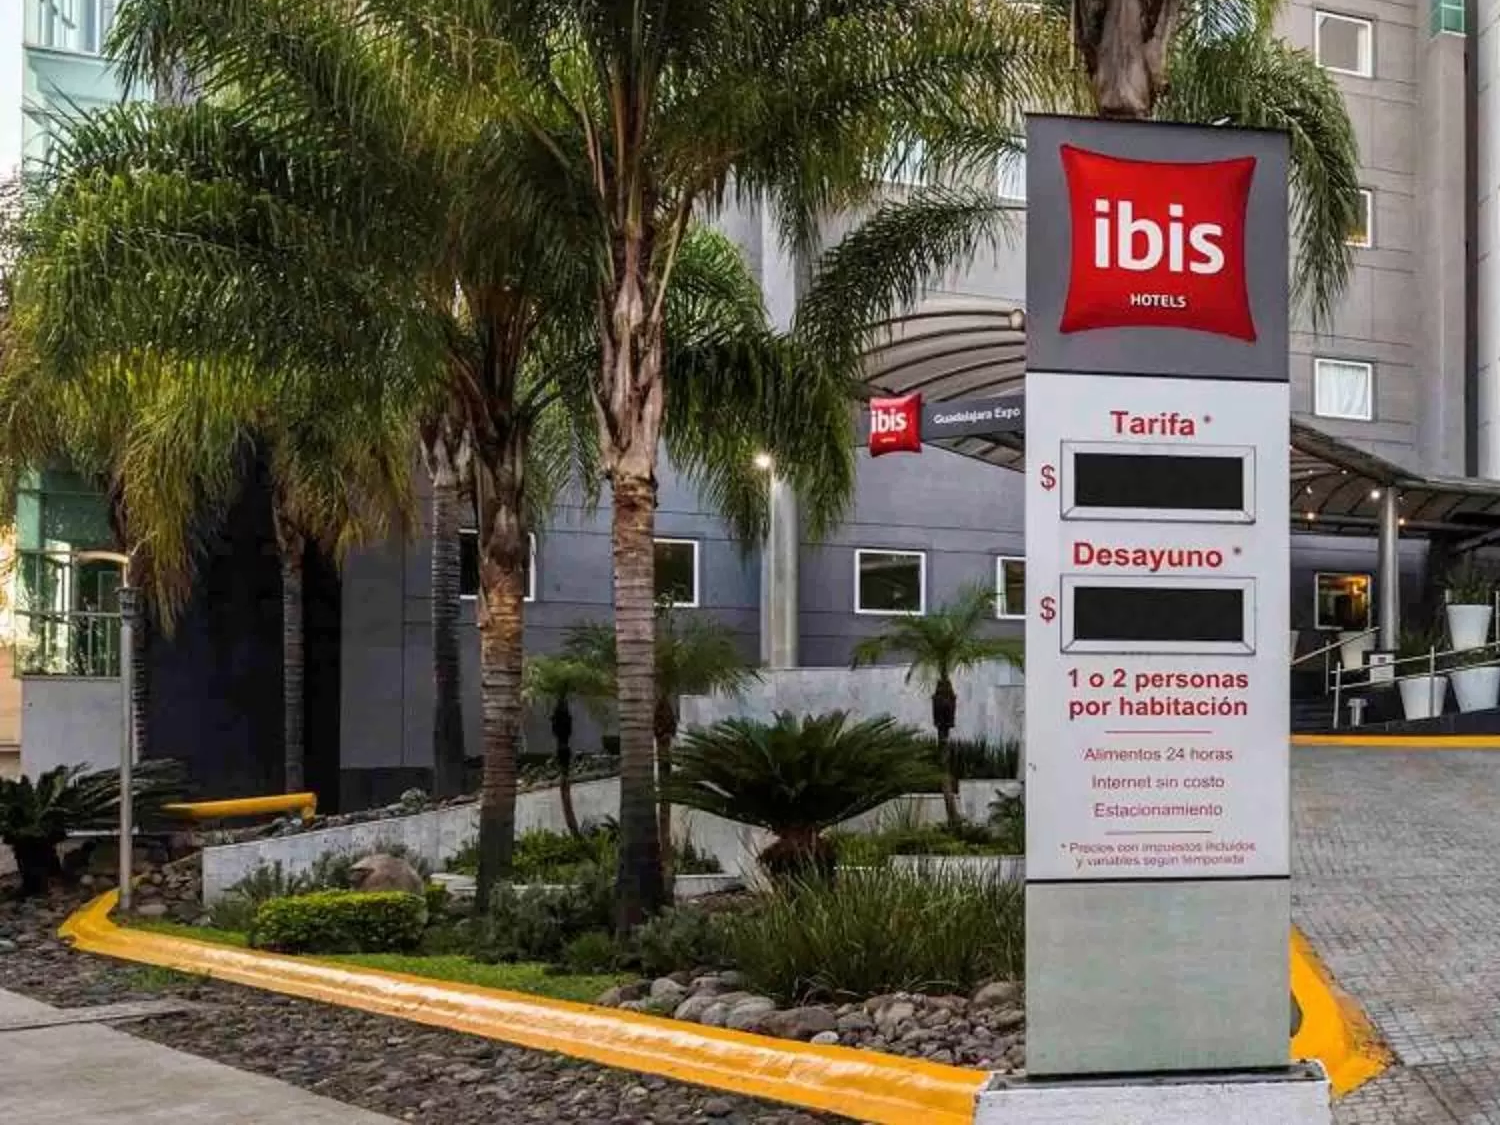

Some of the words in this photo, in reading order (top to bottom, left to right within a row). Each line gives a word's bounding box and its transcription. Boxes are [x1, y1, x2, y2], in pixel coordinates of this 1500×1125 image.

[1094, 198, 1226, 275] ibis
[1130, 294, 1187, 308] HOTELS
[870, 408, 908, 433] ibis
[994, 406, 1021, 420] Expo
[1110, 410, 1196, 436] Tarifa
[1040, 465, 1057, 491] $
[1073, 542, 1223, 572] Desayuno
[1040, 596, 1057, 623] $
[1067, 669, 1079, 688] 1
[1089, 673, 1105, 689] o
[1113, 668, 1127, 688] 2
[1135, 672, 1249, 693] personas
[1069, 700, 1111, 720] por
[1119, 696, 1249, 717] habitación
[1084, 748, 1161, 762] Alimentos
[1166, 747, 1185, 761] 24
[1190, 747, 1234, 762] horas
[1092, 776, 1152, 789] Internet
[1156, 776, 1180, 789] sin
[1183, 776, 1225, 789] costo
[1094, 803, 1223, 818] Estacionamiento
[1069, 843, 1115, 854] Precios
[1117, 844, 1140, 853] con
[1075, 859, 1083, 870] y
